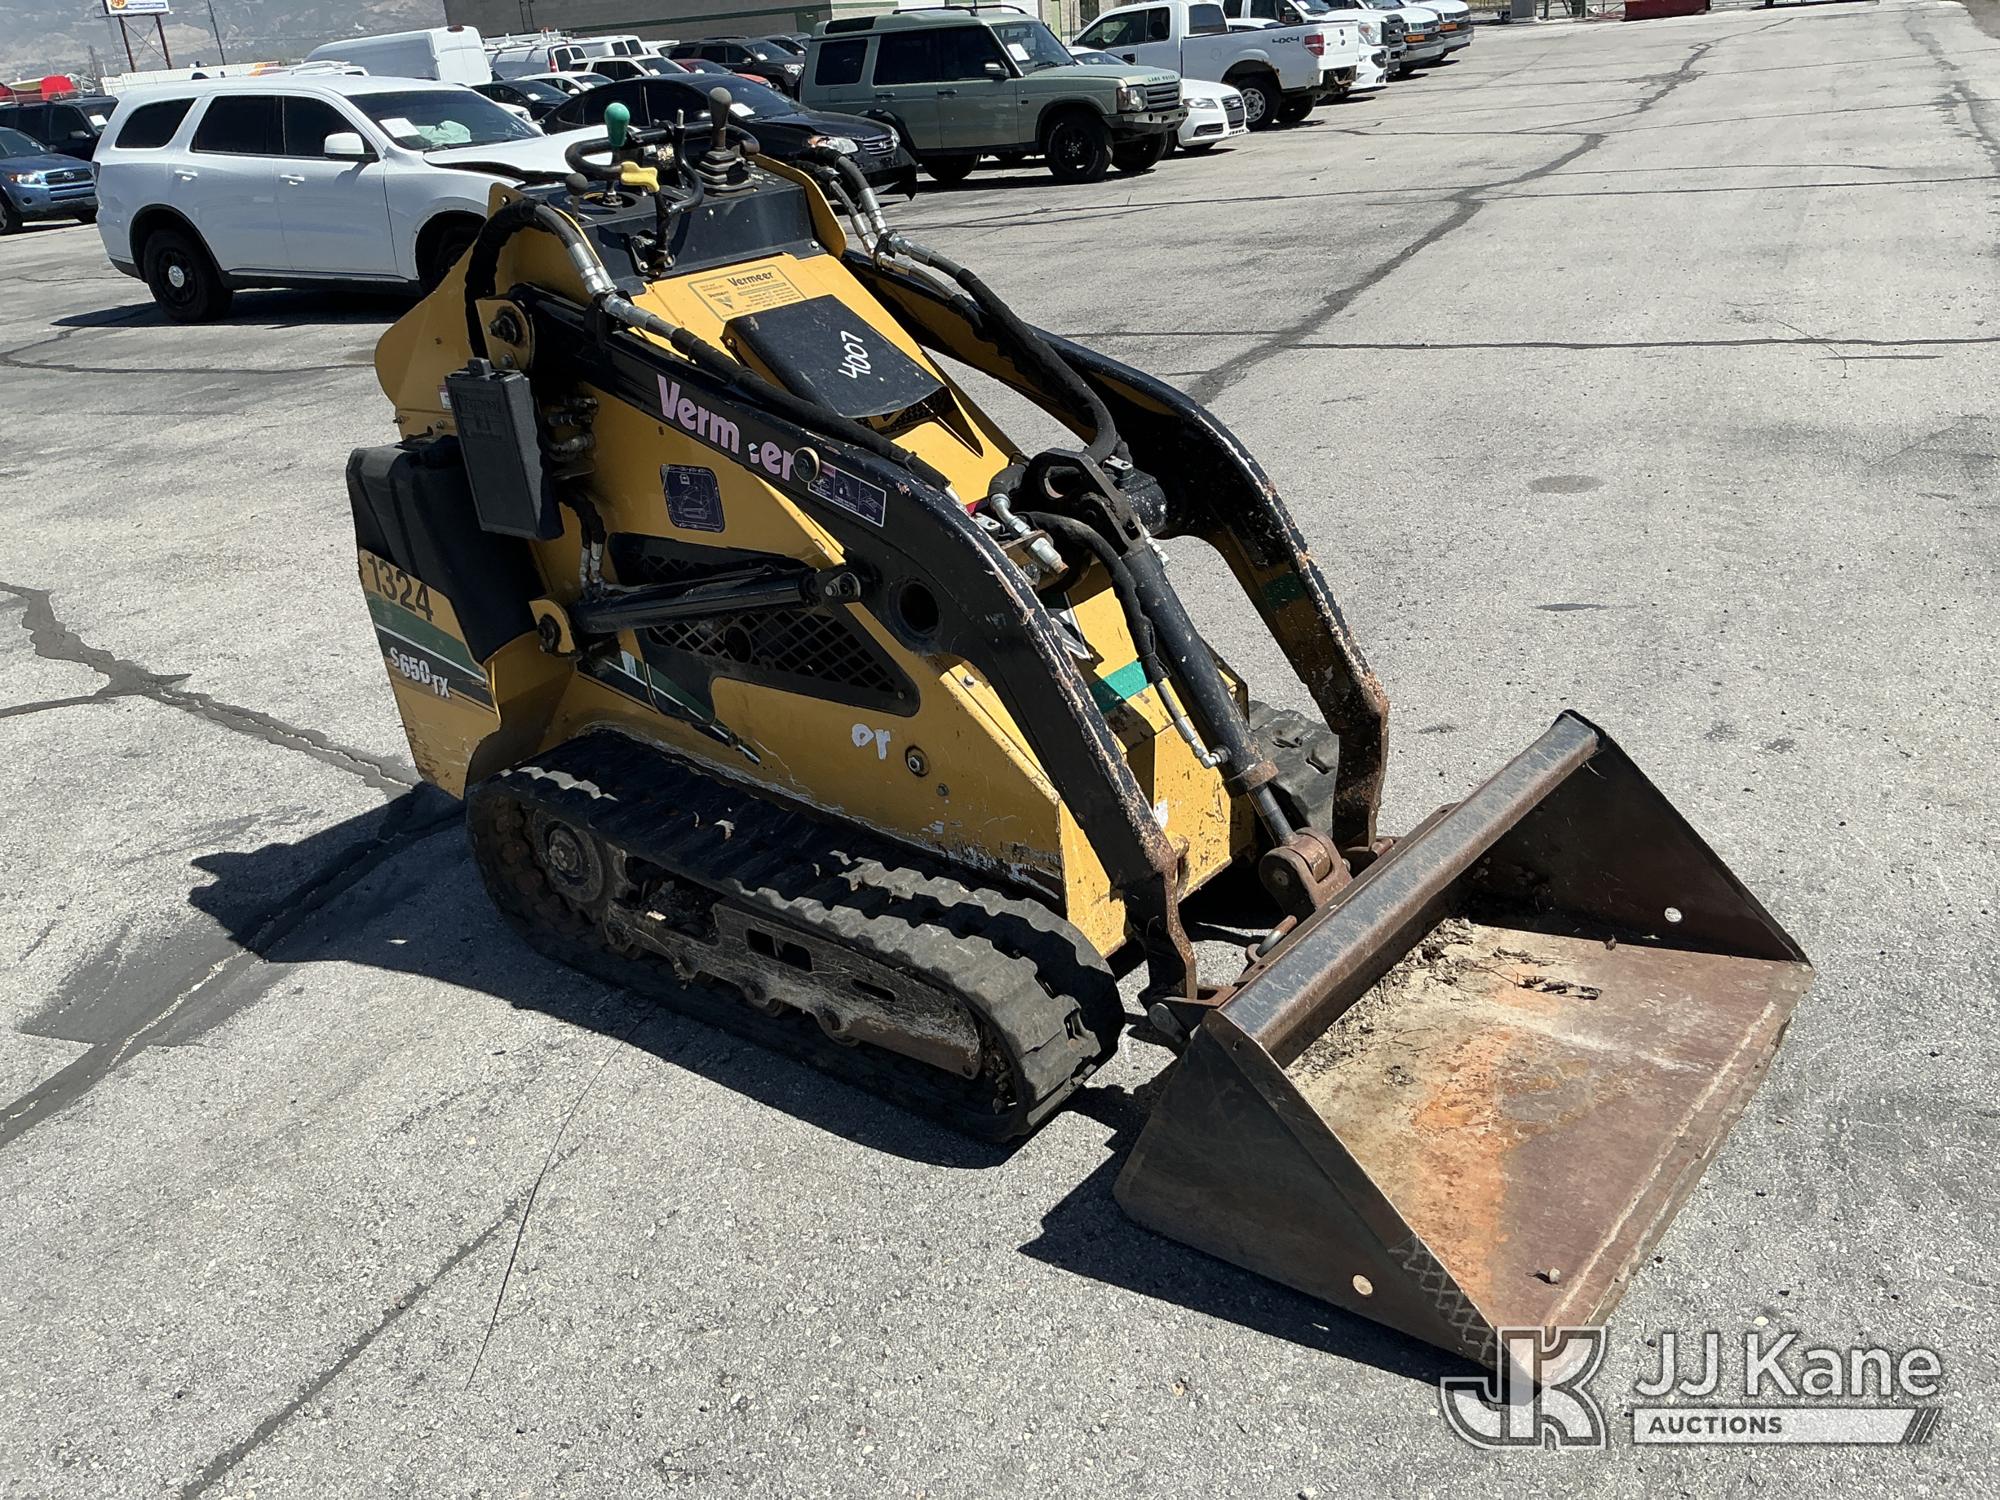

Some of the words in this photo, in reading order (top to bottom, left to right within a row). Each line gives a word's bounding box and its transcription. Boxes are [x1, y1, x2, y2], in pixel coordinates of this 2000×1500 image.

[727, 271, 774, 287] Vermeer
[838, 331, 871, 378] 4007
[368, 554, 433, 622] 1324
